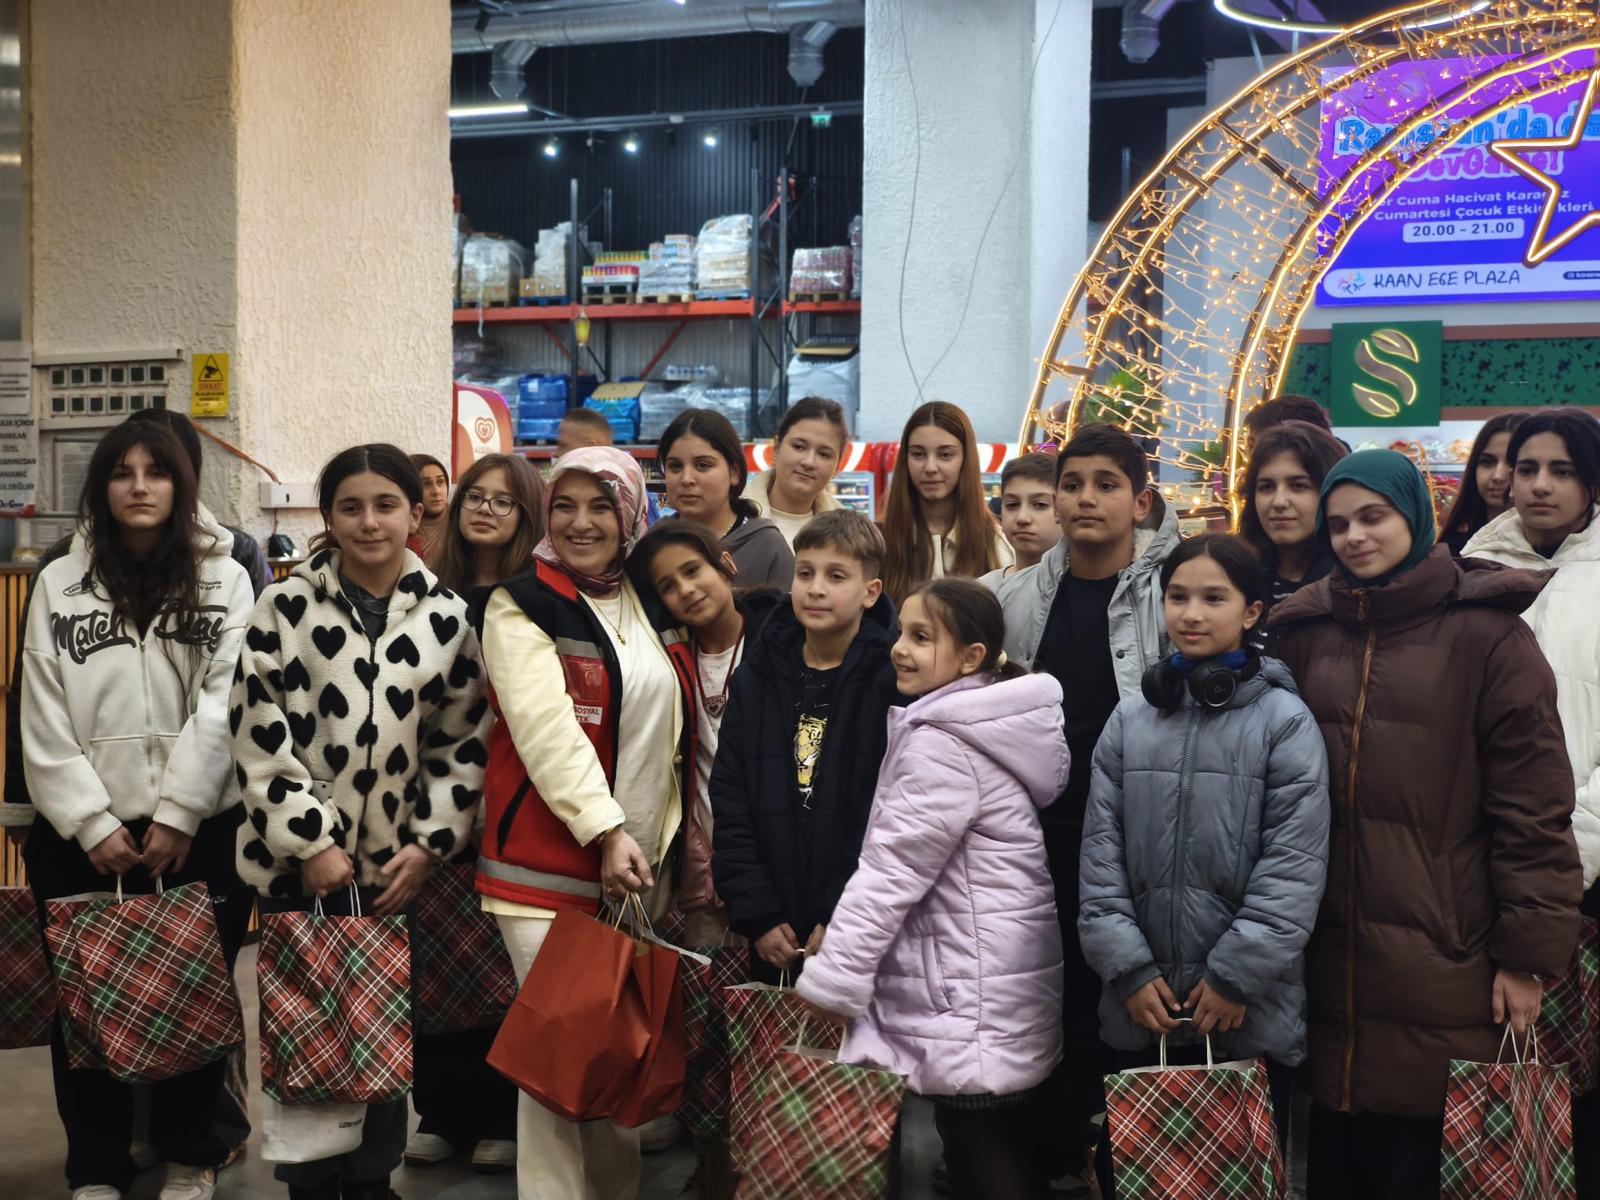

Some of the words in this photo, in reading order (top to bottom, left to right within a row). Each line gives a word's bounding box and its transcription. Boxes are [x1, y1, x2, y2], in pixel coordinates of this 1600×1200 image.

[1397, 196, 1440, 206] Cuma
[1445, 191, 1502, 204] Hacivat
[1506, 190, 1570, 201] Karaz
[1374, 207, 1451, 221] Cumartesi
[1455, 205, 1502, 219] Çocuk
[1412, 225, 1455, 237] 20.00
[1471, 222, 1515, 234] 21.00
[1374, 273, 1422, 288] KAAN
[1428, 271, 1458, 286] EGE
[1464, 270, 1520, 285] PLAZA
[51, 608, 136, 665] Match
